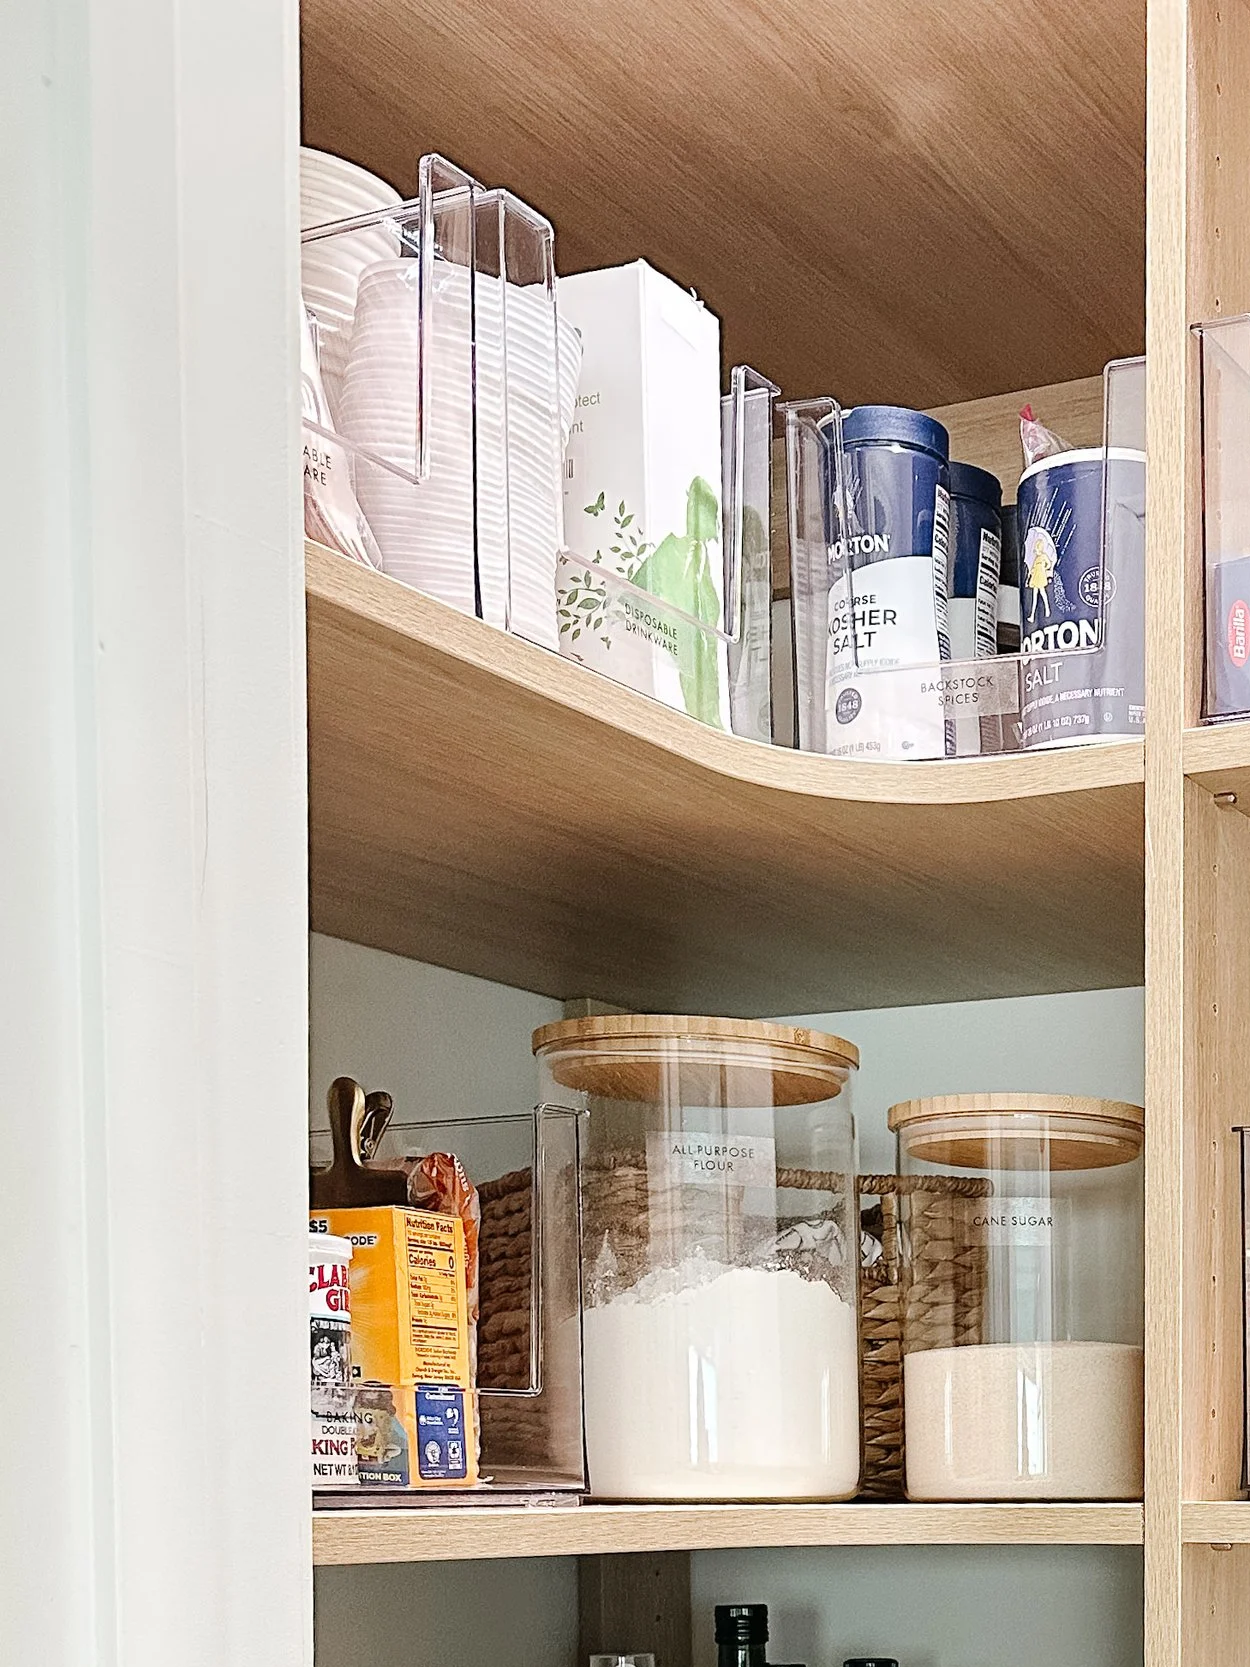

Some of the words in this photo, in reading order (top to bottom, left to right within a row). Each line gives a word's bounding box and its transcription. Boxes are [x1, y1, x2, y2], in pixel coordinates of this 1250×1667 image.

[625, 603, 678, 640] DISPOSABLE
[625, 619, 678, 656] DRINKWARE
[1022, 617, 1104, 664] ORTON
[1233, 607, 1246, 659] Barilla
[833, 631, 877, 655] SALT
[920, 675, 994, 693] BACKSTOCK
[1025, 662, 1063, 692] SALT
[938, 691, 979, 706] SPICES
[697, 1145, 755, 1158] PURPOSE
[694, 1159, 734, 1172] FLOUR
[406, 1217, 435, 1231] Nutrition
[436, 1221, 453, 1234] Facts
[973, 1216, 1007, 1227] CANE
[1011, 1216, 1054, 1227] SUGAR
[408, 1253, 437, 1268] Calories
[448, 1255, 455, 1270] 0
[326, 1410, 373, 1424] BAKING
[313, 1463, 335, 1477] NET
[335, 1463, 347, 1476] WT
[383, 1472, 402, 1482] BOX
